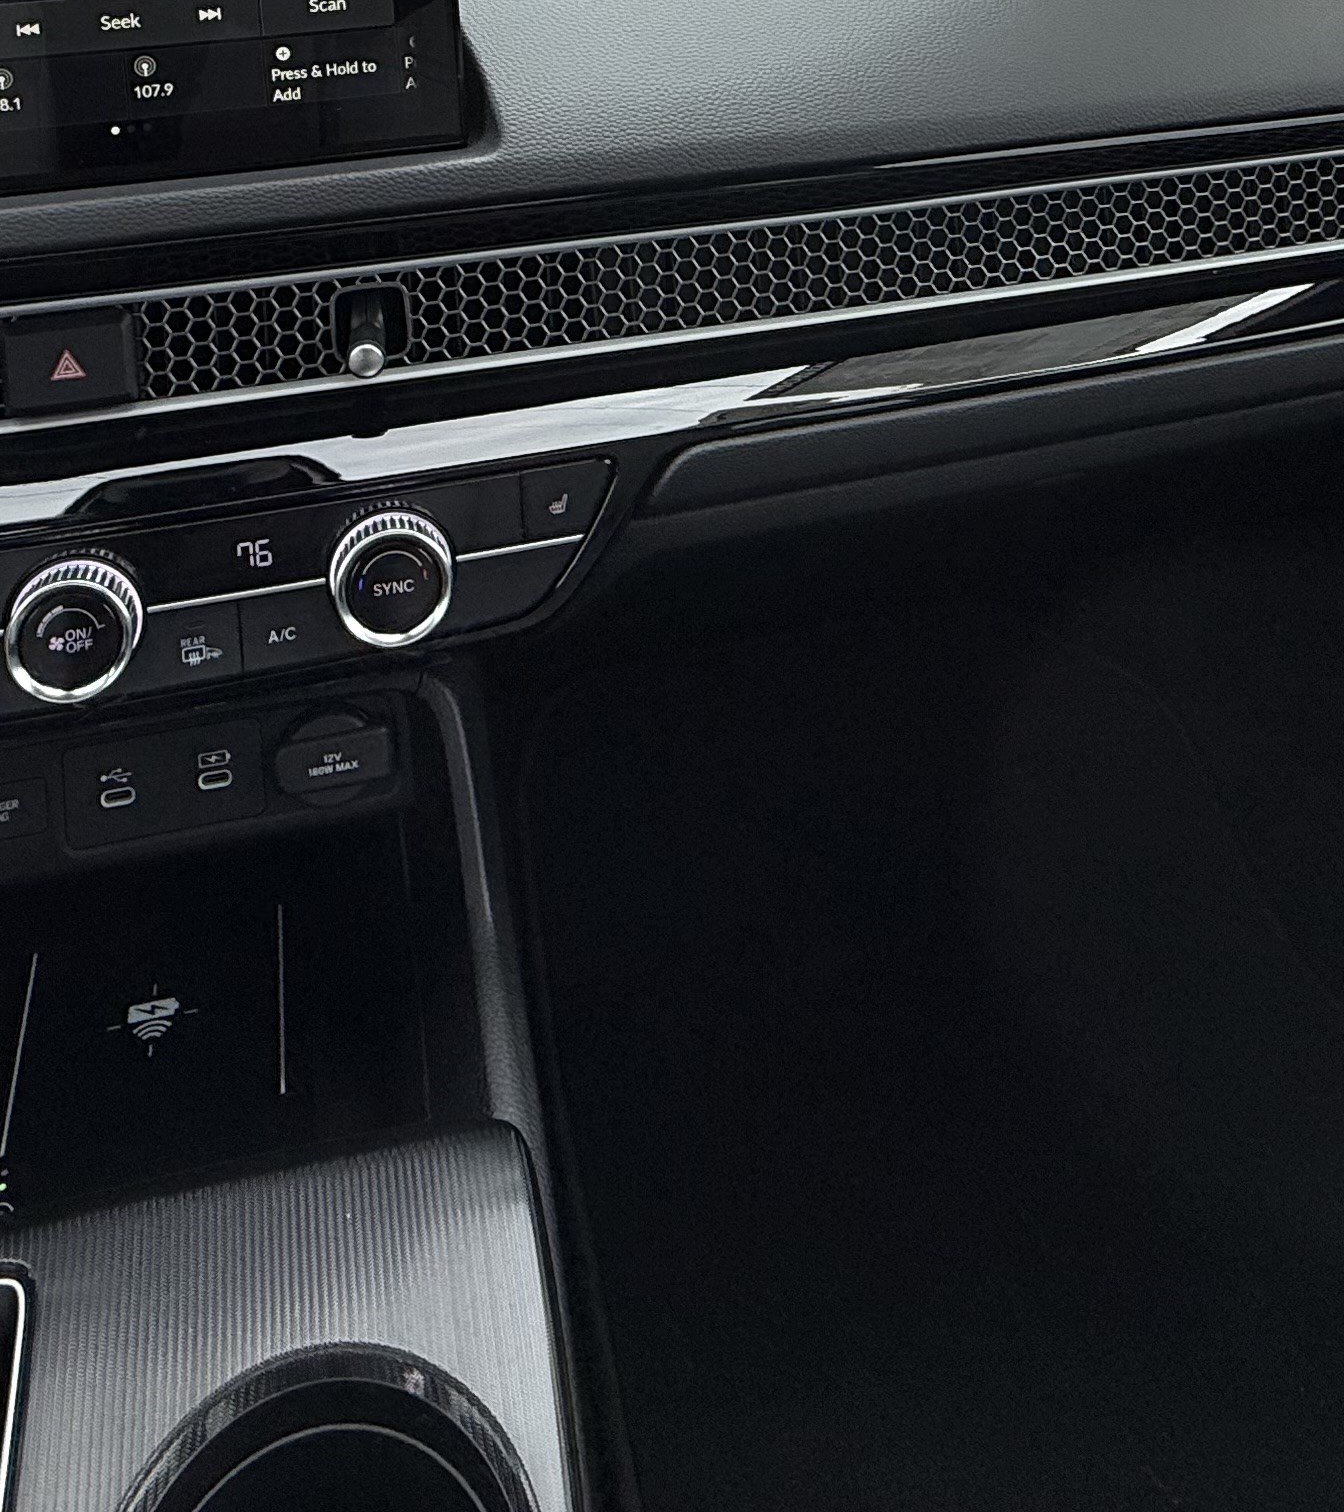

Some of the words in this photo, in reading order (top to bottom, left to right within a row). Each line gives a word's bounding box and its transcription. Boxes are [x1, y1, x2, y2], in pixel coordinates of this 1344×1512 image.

[100, 13, 141, 30] Seek
[271, 67, 307, 83] Press
[311, 65, 322, 78] &
[326, 62, 359, 76] Hold
[362, 61, 377, 73] to
[133, 83, 174, 99] 107.9
[273, 87, 301, 102] Add
[236, 538, 274, 569] 76
[373, 579, 415, 597] SYNC
[65, 625, 93, 642] ON/
[180, 635, 206, 649] REAR
[268, 626, 297, 645] A/C
[66, 638, 94, 655] OFF
[323, 752, 342, 764] 12V
[336, 760, 359, 772] MAX
